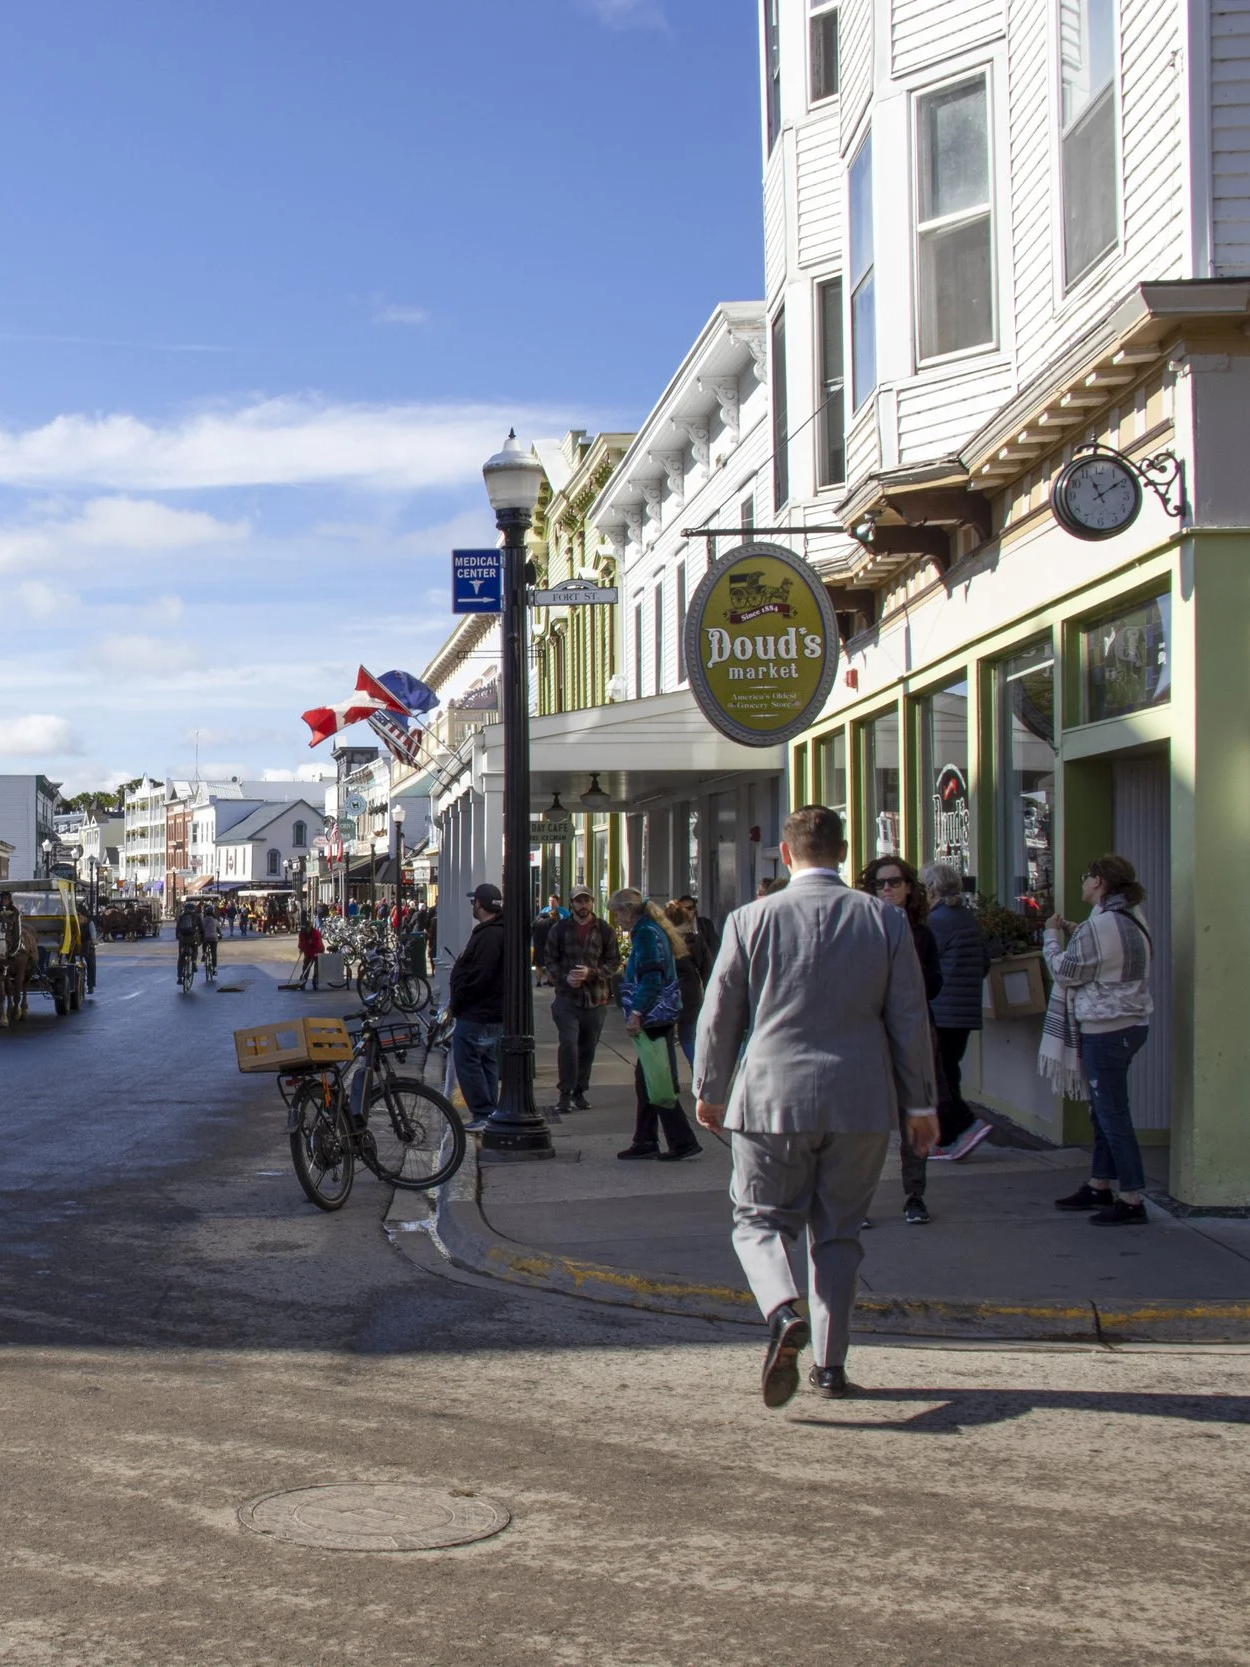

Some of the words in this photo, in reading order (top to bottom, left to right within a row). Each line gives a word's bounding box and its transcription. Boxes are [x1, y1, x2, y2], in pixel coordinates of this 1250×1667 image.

[454, 556, 499, 567] MEDICAL
[457, 568, 497, 578] CENTER
[552, 593, 579, 602] FORT
[740, 609, 761, 621] Since
[761, 604, 779, 616] 1884
[702, 627, 822, 669] Doud's
[728, 662, 799, 680] market
[731, 693, 771, 701] America's
[771, 692, 798, 700] Oldest
[736, 702, 768, 710] Grocery
[772, 700, 792, 709] Store
